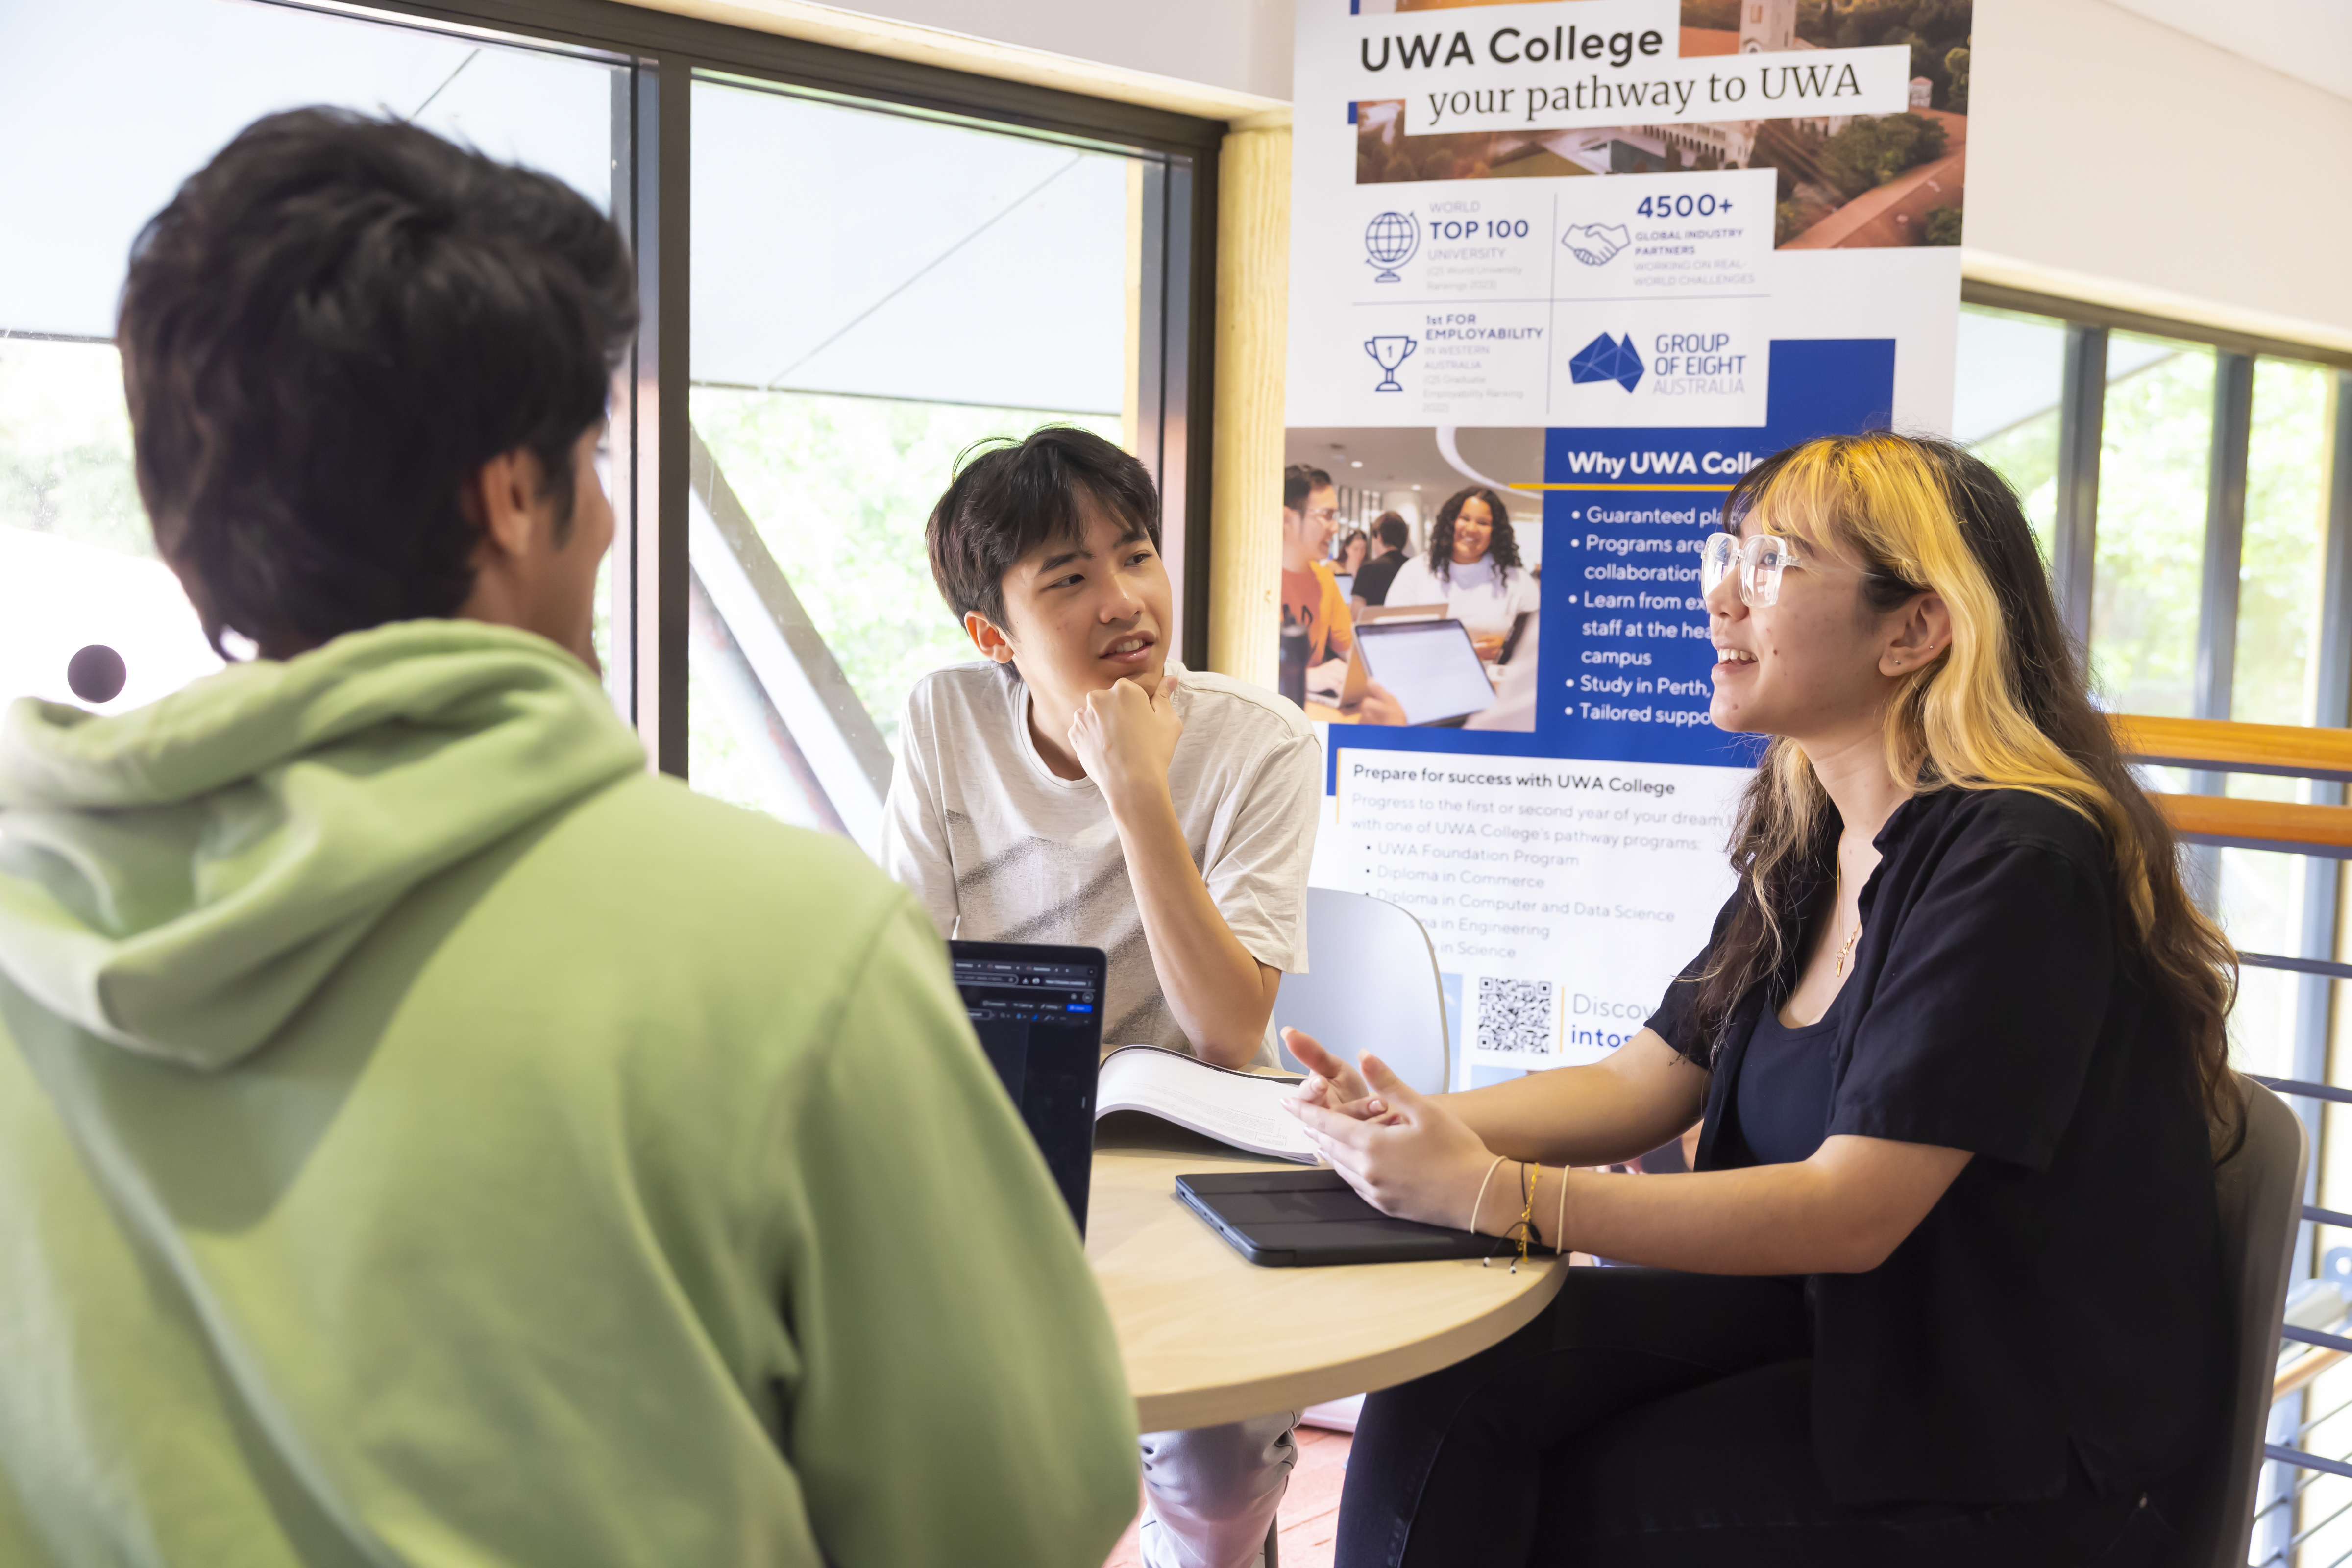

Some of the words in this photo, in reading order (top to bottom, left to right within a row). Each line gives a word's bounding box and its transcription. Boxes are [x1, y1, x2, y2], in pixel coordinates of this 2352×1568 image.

[1361, 32, 1475, 72] UWA
[1490, 25, 1663, 67] College
[1429, 86, 1516, 125] your
[1526, 75, 1696, 121] pathway
[1709, 74, 1746, 102] to
[1761, 62, 1862, 99] UWA
[1429, 200, 1481, 213] WORLD
[1636, 193, 1733, 218] 4500+
[1429, 220, 1478, 239] TOP
[1487, 219, 1529, 238] 100
[1635, 230, 1681, 242] GLOBAL
[1685, 228, 1744, 240] INDUSTRY
[1427, 246, 1507, 261] UNIVERSITY
[1635, 245, 1695, 256] PARTNERS
[1634, 260, 1691, 271] WORKING
[1633, 275, 1677, 287] WORLD
[1678, 273, 1756, 285] CHALLENGES
[1426, 315, 1442, 325] 1st
[1446, 313, 1476, 325] FOR
[1425, 328, 1544, 341] EMPLOYABILITY
[1655, 333, 1730, 354] GROUP
[1386, 345, 1393, 358] 1
[1438, 344, 1490, 355] WESTERN
[1424, 360, 1482, 370] AUSTRALIA
[1655, 357, 1680, 376] OF
[1686, 355, 1747, 376] EIGHT
[1652, 378, 1745, 396] AUSTRALIA
[1568, 451, 1626, 480] Why
[1630, 451, 1699, 475] UWA
[1586, 505, 1696, 525] Guaranteed
[1586, 534, 1673, 556] Programs
[1675, 538, 1705, 553] are
[1584, 563, 1702, 582] collaboration
[1584, 590, 1635, 609] Learn
[1639, 591, 1682, 610] from
[1685, 596, 1711, 615] ex
[1582, 618, 1623, 637] staff
[1625, 621, 1643, 637] at
[1647, 620, 1678, 638] the
[1581, 650, 1652, 669] campus
[1579, 674, 1633, 697] Study
[1636, 676, 1653, 694] in
[1657, 676, 1712, 699] Perth,
[1579, 701, 1652, 723] Tailored
[1655, 709, 1714, 729] suppo
[1353, 764, 1417, 783] Prepare
[1421, 767, 1444, 783] for
[1448, 772, 1512, 786] success
[1517, 773, 1552, 788] with
[1558, 774, 1604, 790] UWA
[1609, 777, 1676, 798] College
[1352, 792, 1415, 810] Progress
[1420, 798, 1435, 810] to
[1438, 799, 1463, 812] the
[1467, 799, 1494, 814] first
[1497, 803, 1514, 814] or
[1518, 805, 1574, 817] second
[1577, 807, 1610, 821] year
[1613, 808, 1630, 821] of
[1633, 811, 1667, 826] your
[1671, 811, 1723, 827] dream
[1350, 818, 1381, 831] with
[1385, 821, 1413, 833] one
[1416, 820, 1432, 833] of
[1434, 822, 1477, 836] UWA
[1480, 823, 1550, 843] College's
[1554, 829, 1619, 848] pathway
[1377, 841, 1419, 856] UWA
[1421, 844, 1510, 863] Foundation
[1513, 849, 1579, 868] Program
[1376, 864, 1439, 882] Diploma
[1442, 868, 1456, 882] in
[1459, 869, 1545, 889] Commerce
[1376, 888, 1439, 906] Diploma
[1442, 892, 1455, 906] in
[1459, 893, 1537, 912] Computer
[1541, 900, 1570, 915] and
[1574, 901, 1611, 918] Data
[1614, 904, 1676, 923] Science
[1441, 916, 1455, 930] in
[1458, 917, 1551, 940] Engineering
[1440, 940, 1454, 954] in
[1457, 941, 1517, 959] Science
[1573, 993, 1657, 1020] Discov
